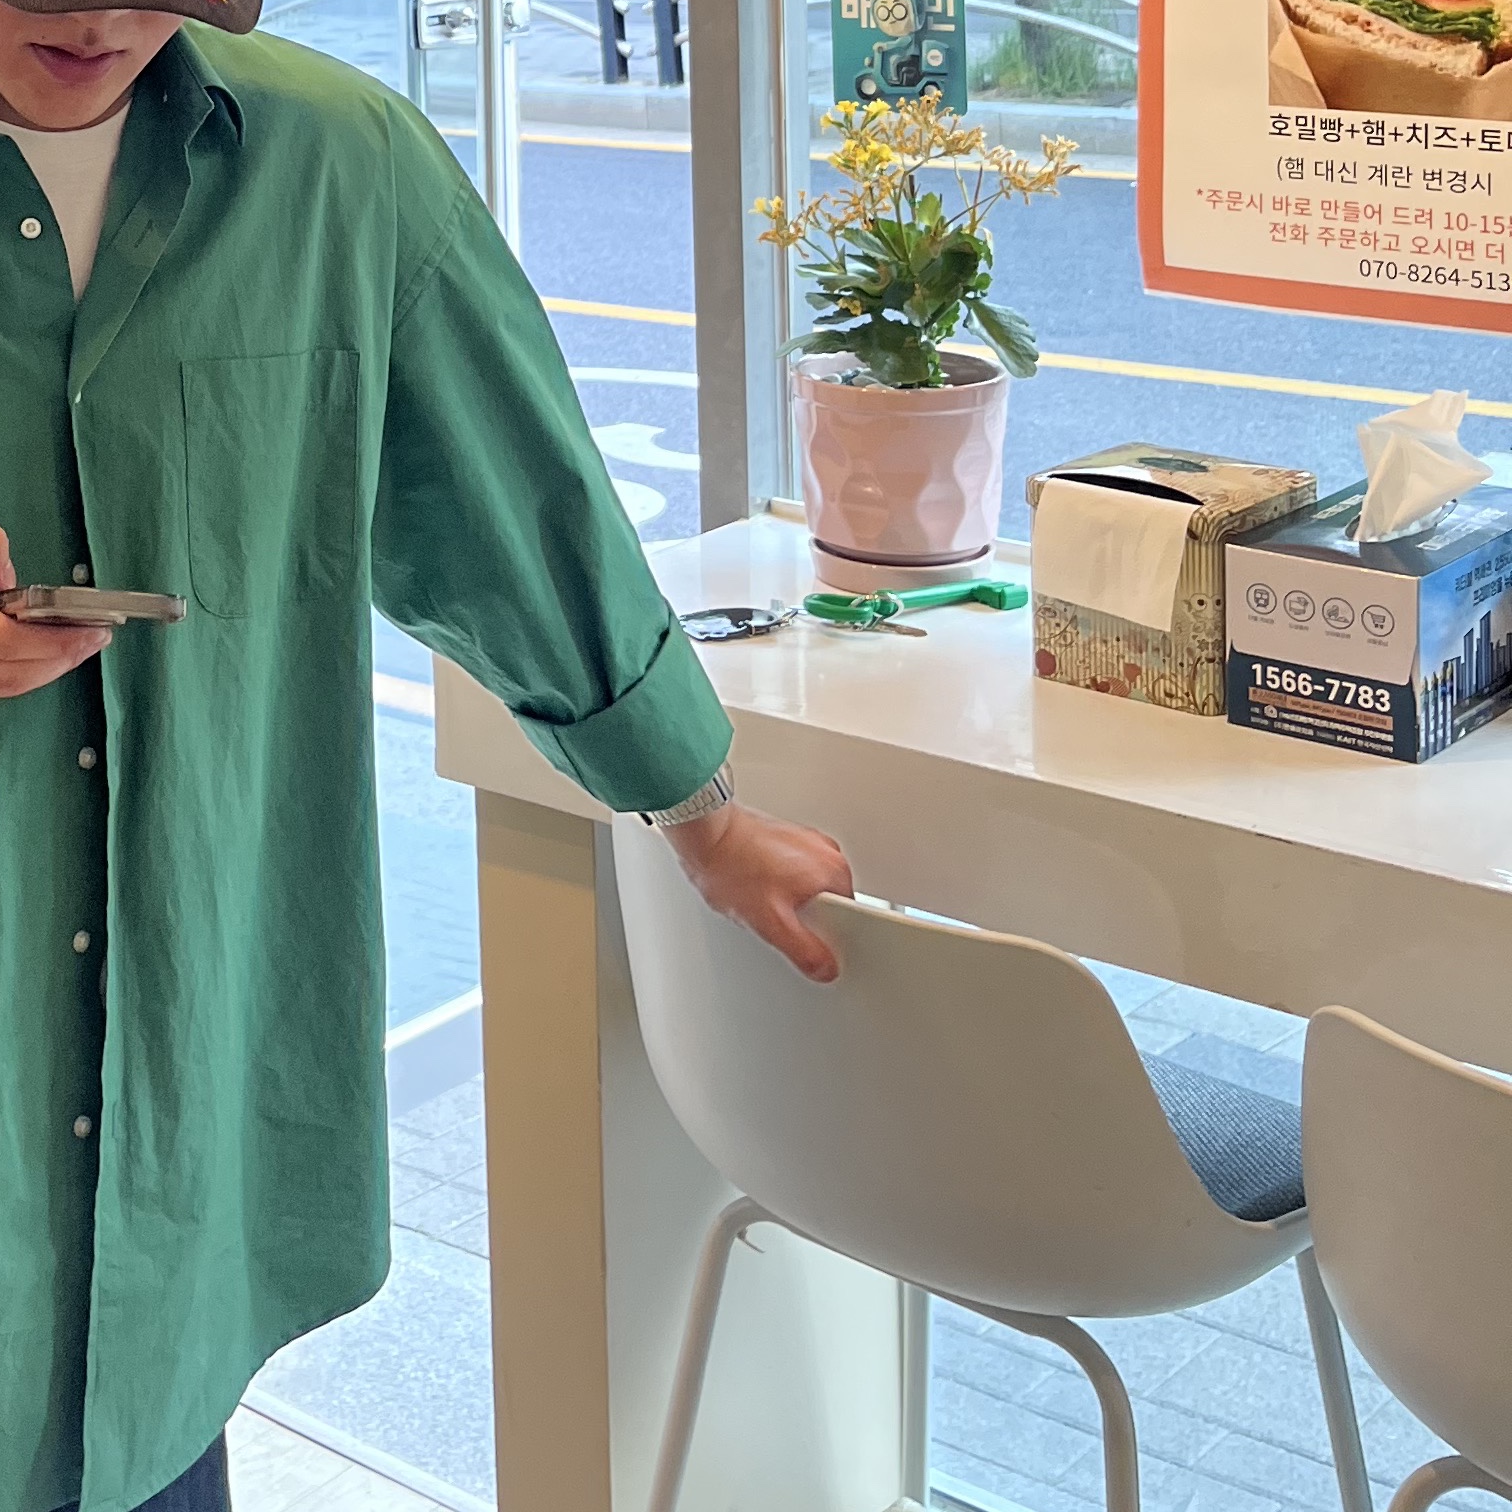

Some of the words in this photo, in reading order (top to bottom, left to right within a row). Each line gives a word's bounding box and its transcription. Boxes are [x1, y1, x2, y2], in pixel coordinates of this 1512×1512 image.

[1268, 112, 1512, 153] 호밀빵+햄+치즈+토
[1276, 155, 1305, 182] (햄
[1314, 159, 1358, 185] 대신
[1367, 163, 1414, 189] 계란
[1422, 167, 1492, 197] 변경시
[1272, 194, 1313, 217] 바로
[1320, 198, 1383, 226] 만들어
[1391, 205, 1433, 230] 드려
[1443, 211, 1512, 238] 10-15
[1269, 221, 1310, 246] 전화
[1316, 225, 1402, 253] 주문하고
[1409, 235, 1476, 262] 오시면
[1485, 242, 1506, 265] 더
[1359, 258, 1511, 292] 070-8264-513
[1251, 662, 1392, 713] 1566-7783
